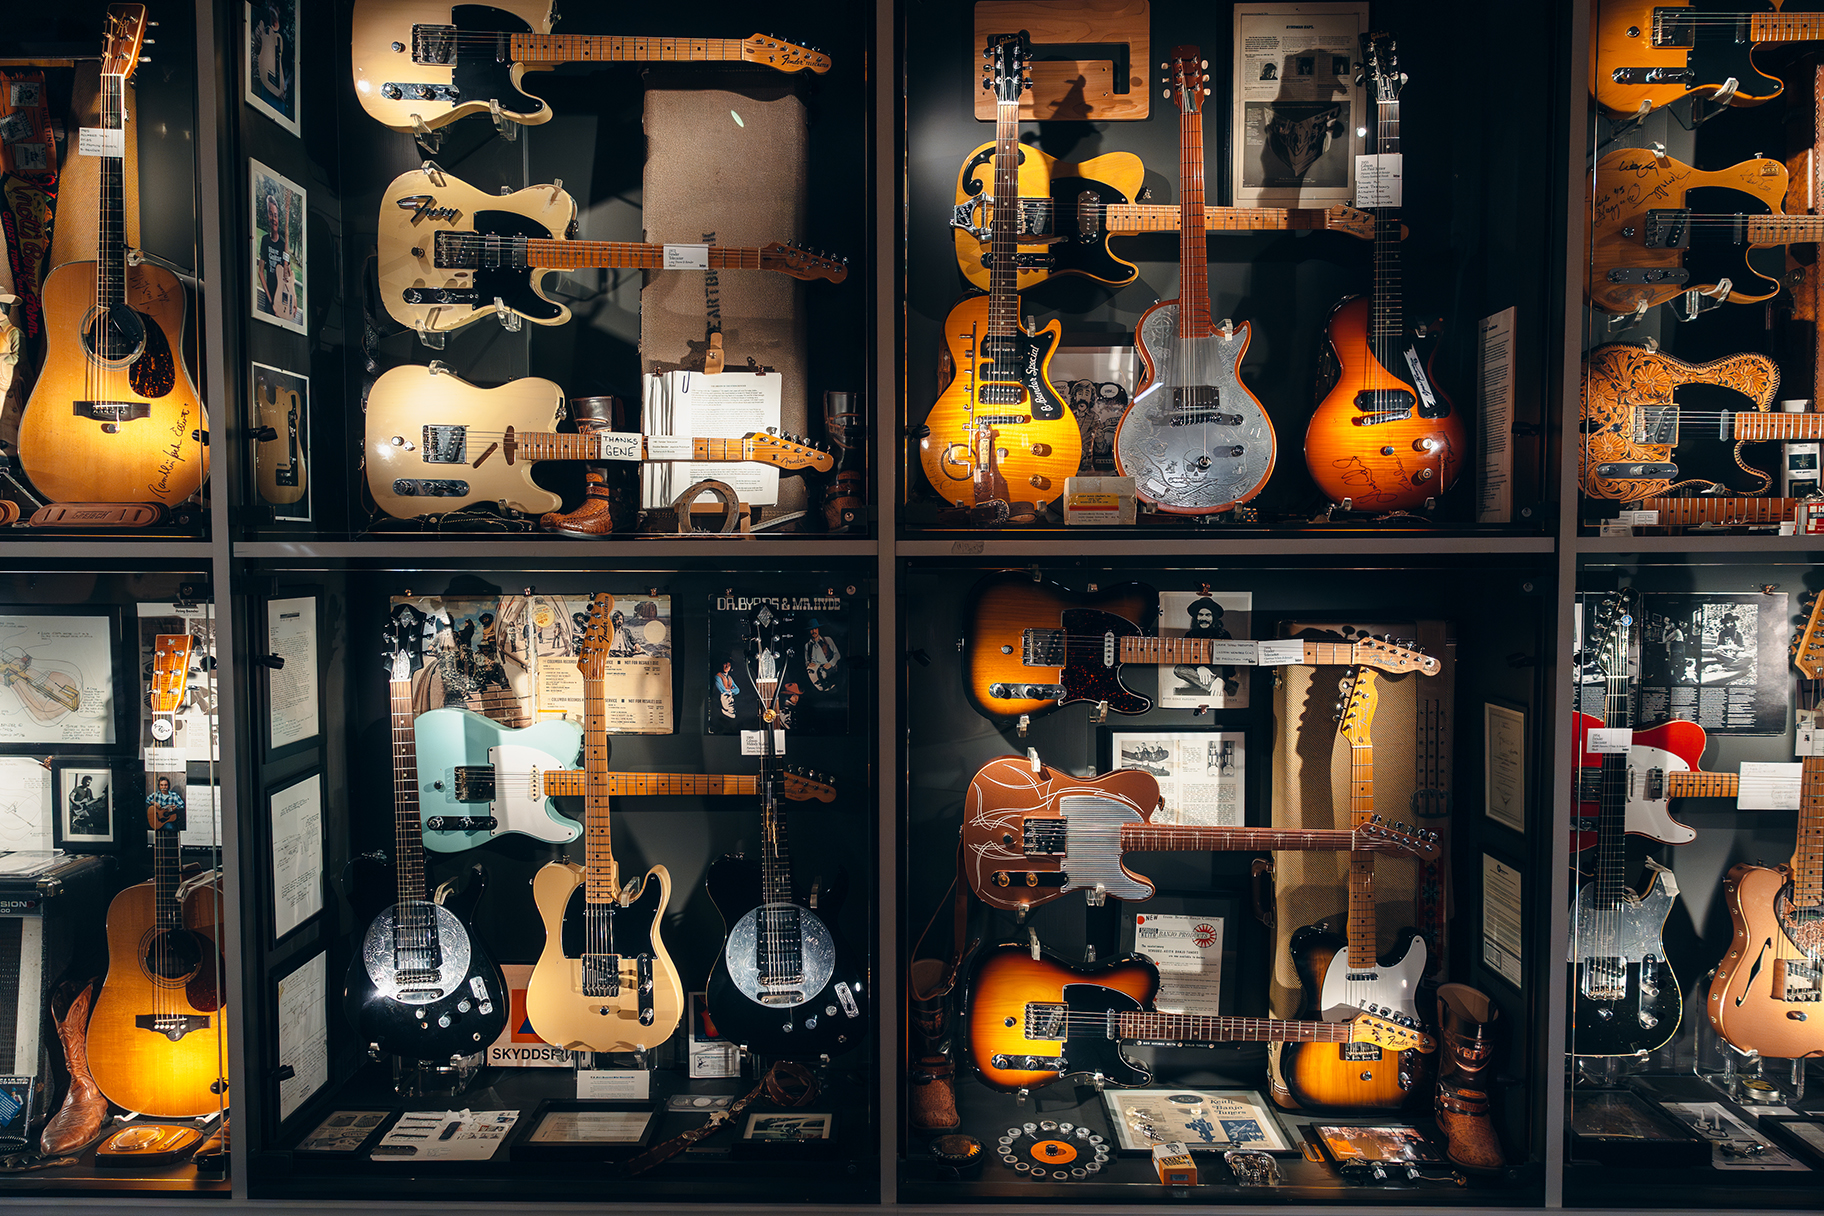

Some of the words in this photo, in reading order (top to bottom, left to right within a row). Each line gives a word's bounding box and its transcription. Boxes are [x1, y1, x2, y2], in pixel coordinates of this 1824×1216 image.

[782, 54, 804, 66] Fender
[1025, 344, 1040, 378] Special
[603, 435, 639, 446] THANKS
[605, 445, 637, 457] GENE
[780, 455, 806, 467] Fender
[781, 597, 791, 611] &
[813, 597, 841, 611] HYDE
[598, 620, 610, 643] Fender
[1370, 654, 1398, 667] Fender
[1387, 1035, 1408, 1046] Fender
[492, 1048, 586, 1061] SKYDDSR
